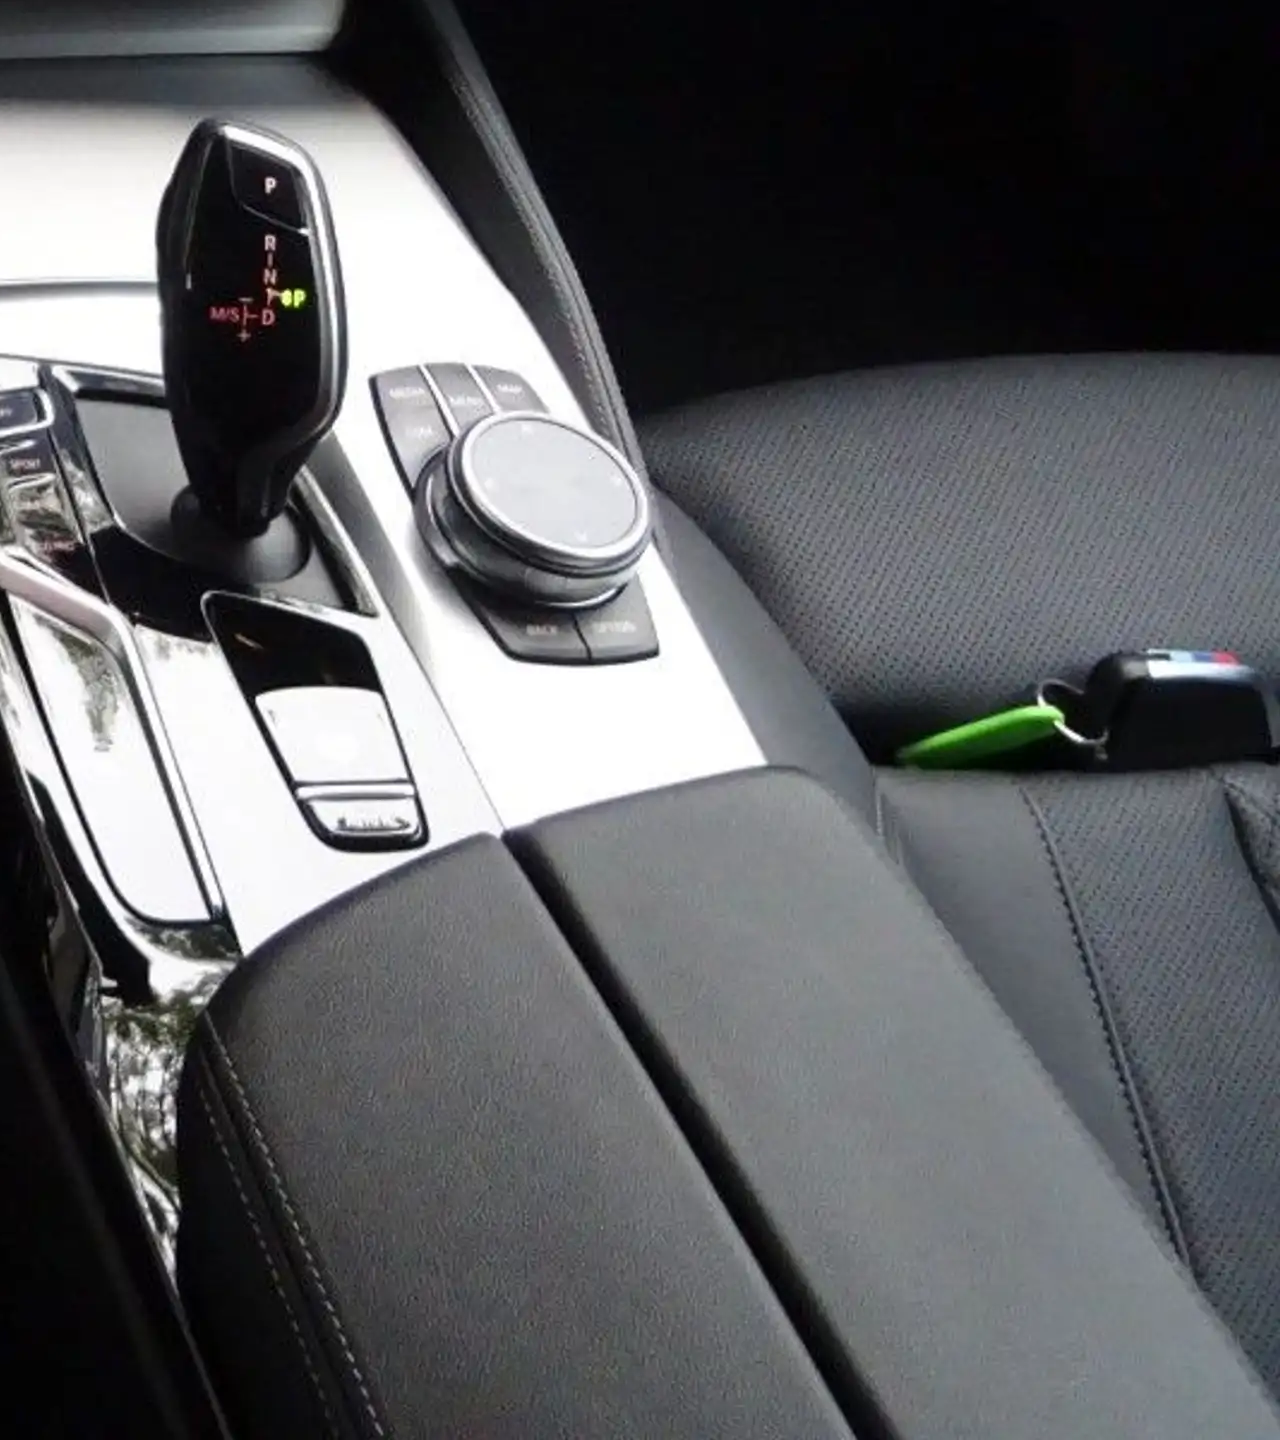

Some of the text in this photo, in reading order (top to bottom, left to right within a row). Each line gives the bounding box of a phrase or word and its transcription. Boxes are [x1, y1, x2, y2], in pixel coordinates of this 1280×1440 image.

[264, 176, 277, 194] P
[264, 235, 276, 251] R
[263, 268, 277, 285] N
[209, 306, 240, 322] M/S
[261, 310, 276, 326] D
